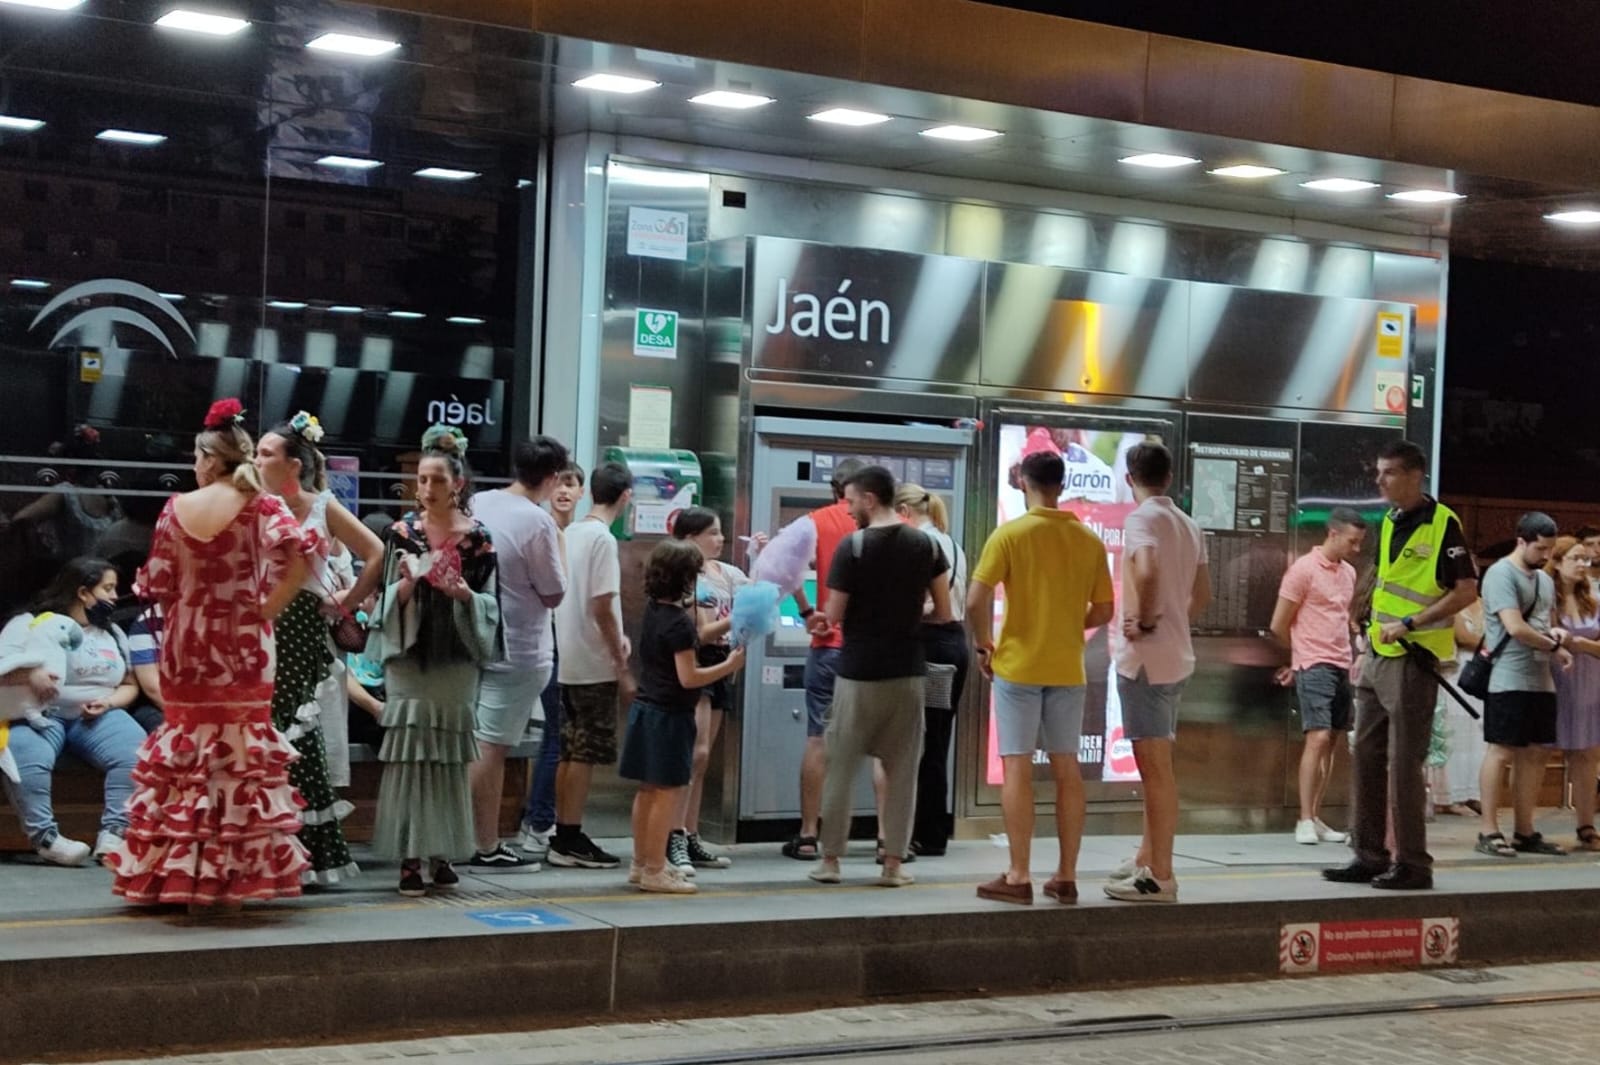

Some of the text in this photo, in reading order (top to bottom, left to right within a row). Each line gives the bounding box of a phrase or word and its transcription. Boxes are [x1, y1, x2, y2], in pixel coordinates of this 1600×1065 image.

[765, 278, 890, 344] Jaén
[640, 333, 673, 346] DESA
[1061, 467, 1112, 491] jarón
